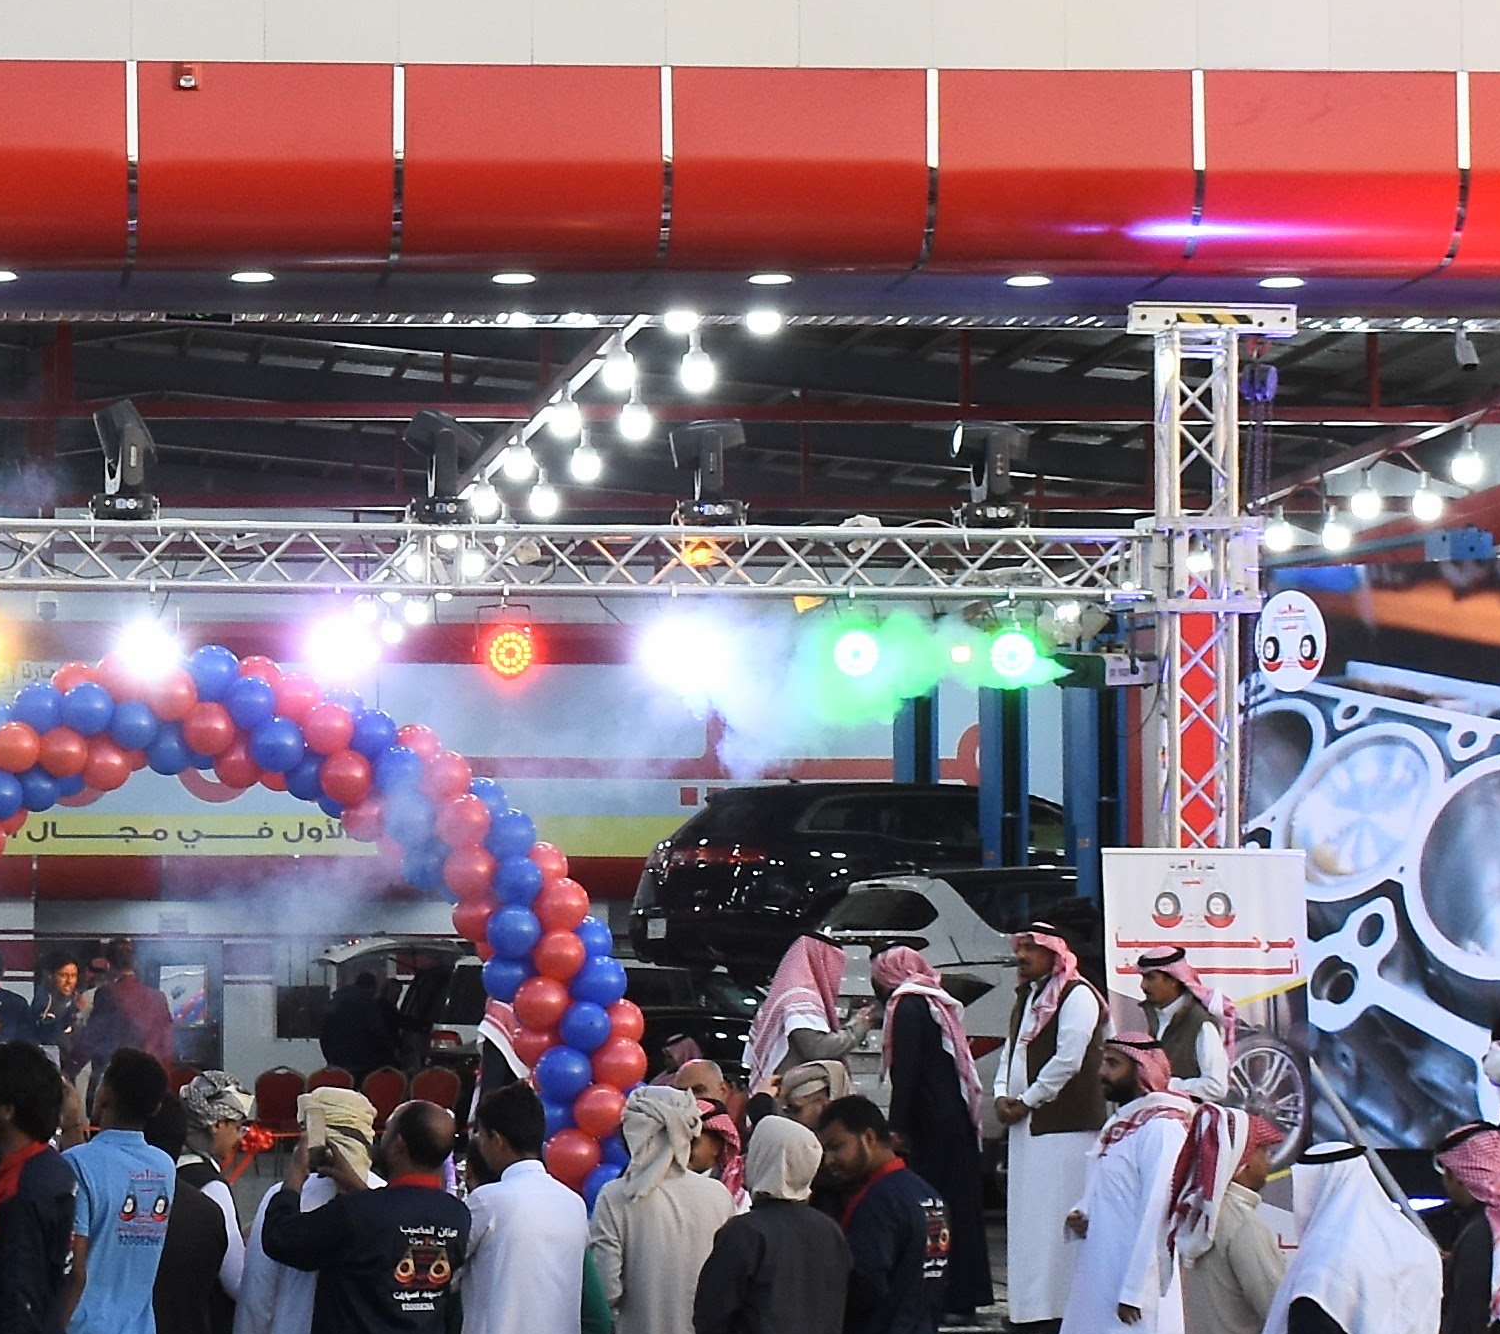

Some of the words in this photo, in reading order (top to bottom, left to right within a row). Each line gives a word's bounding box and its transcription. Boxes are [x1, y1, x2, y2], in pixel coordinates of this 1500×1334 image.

[26, 821, 169, 844] مجال
[177, 821, 274, 848] في
[282, 818, 345, 843] لأول
